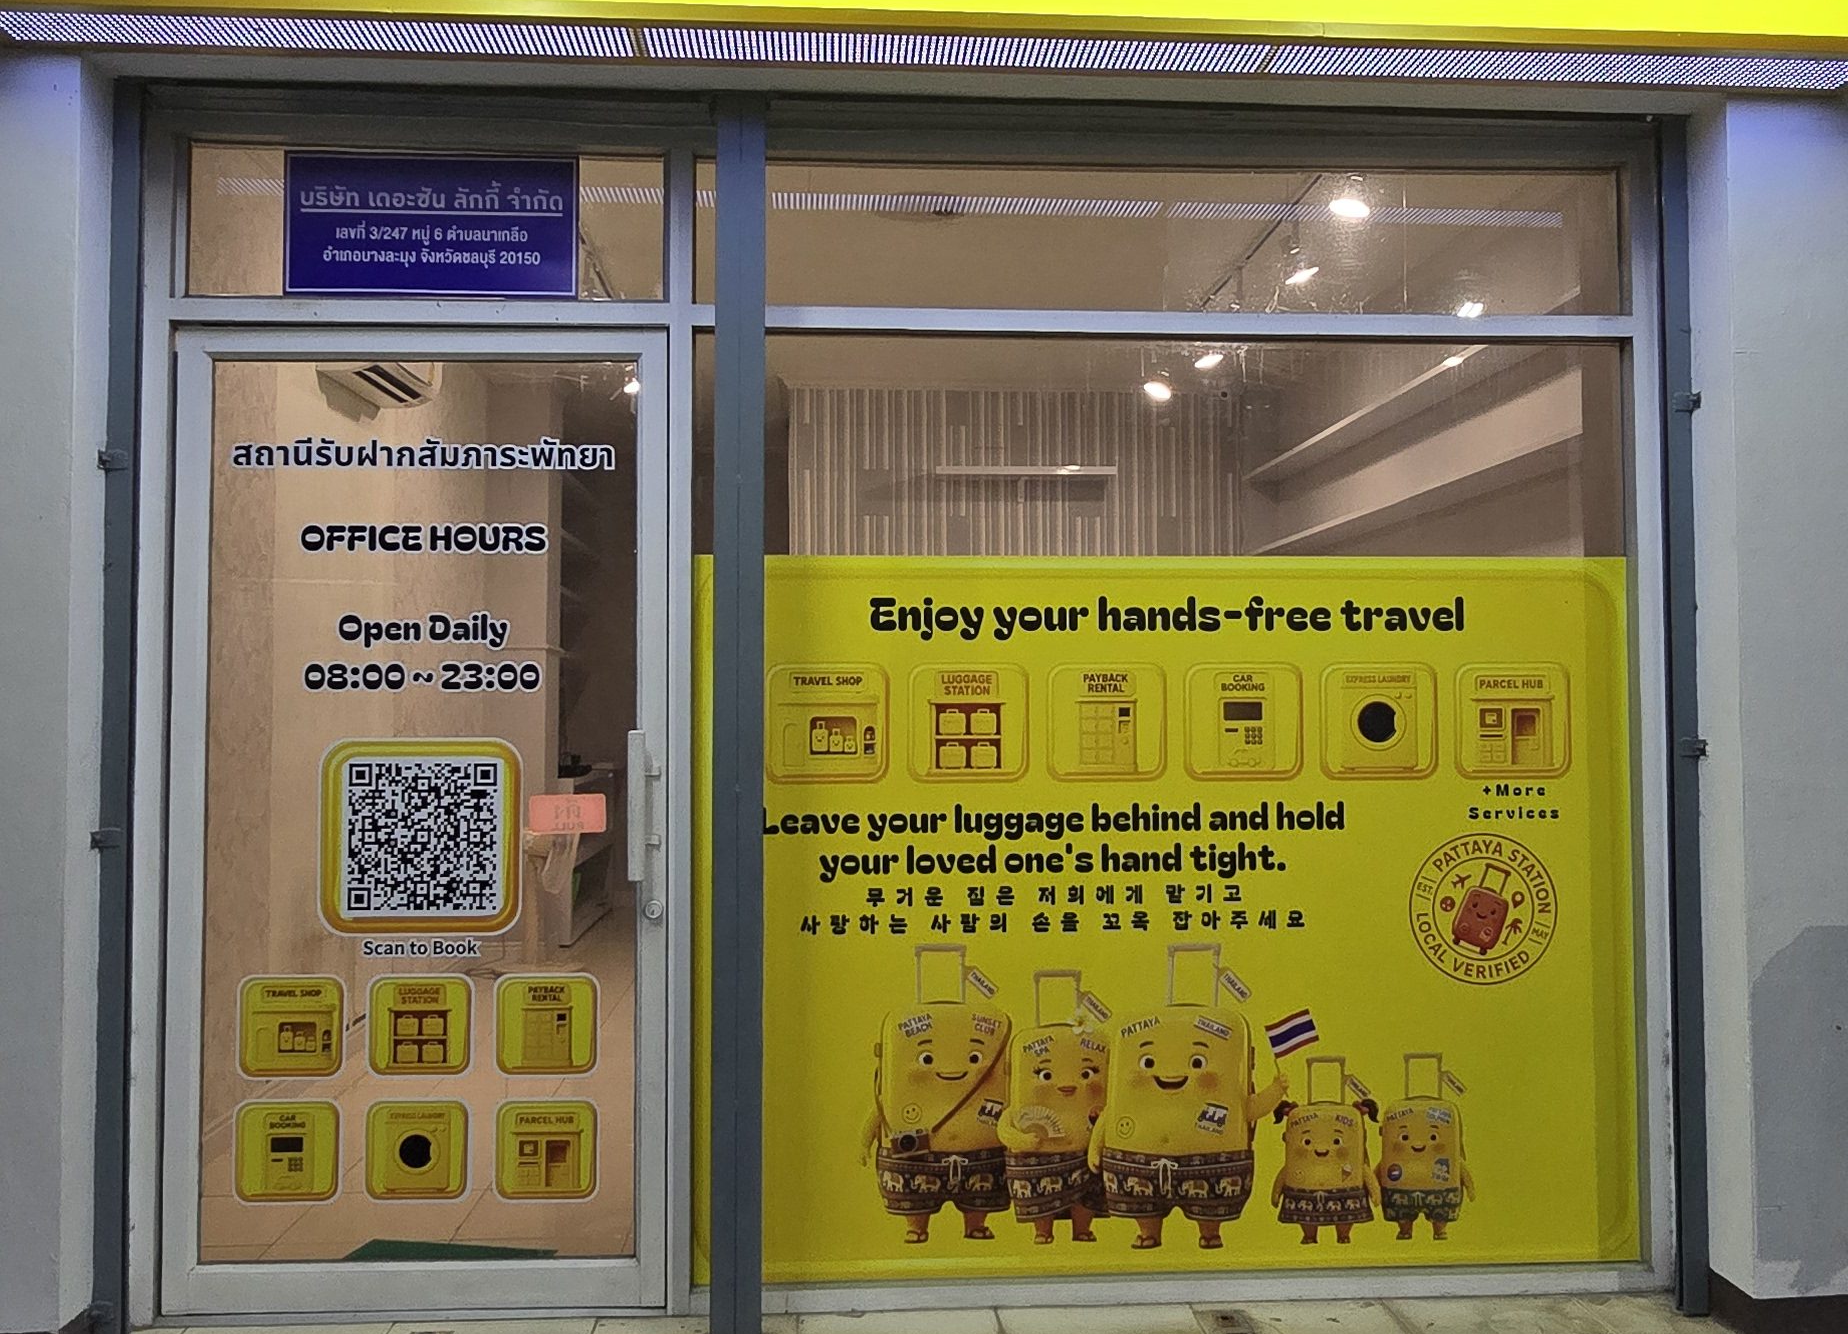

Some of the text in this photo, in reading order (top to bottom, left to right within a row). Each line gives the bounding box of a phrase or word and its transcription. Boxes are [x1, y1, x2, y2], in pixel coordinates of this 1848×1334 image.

[300, 180, 563, 211] บริษัท เดอะซัน ลักกี้ จำกัด
[335, 221, 529, 245] เลขที่ 3/247 หมู่ 6 ตำบลนาเกลือ
[323, 245, 541, 269] อำเภอบางละมุง จังหวัดชลบุรี 20150
[232, 437, 614, 468] สถานีรับฝากสัมภาระพัทยา
[301, 524, 547, 552] OFFICE HOURS
[869, 596, 1465, 641] Enjoy your hands-free travel
[338, 613, 509, 647] Open Daily
[304, 663, 405, 690] 08:00
[441, 663, 540, 690] 23:00
[793, 676, 863, 687] TRAVEL SHOP
[941, 674, 993, 685] LUGGAGE
[1083, 673, 1128, 684] PAYBACK
[1232, 674, 1253, 683] CAR
[1479, 679, 1544, 689] PARCEL HUB
[943, 685, 991, 696] STATION
[1087, 683, 1125, 693] RENTAL
[1221, 682, 1265, 692] BOOKING
[1468, 806, 1560, 819] Services
[763, 801, 1345, 841] Leave your luggage behind and hold
[819, 842, 1286, 882] your loved one's hand tight.
[1432, 839, 1552, 914] PATTAYA STATION
[866, 886, 943, 907] 무거운
[1038, 884, 1143, 905] 저희에게
[1166, 884, 1242, 904] 맡기고
[800, 913, 908, 935] 사랑하는
[931, 912, 1007, 934] 사람의
[1032, 912, 1079, 932] 손을
[1173, 910, 1305, 931] 잡아주세요
[363, 939, 477, 956] Scan to Book
[1416, 912, 1530, 979] LOCAL VERIFIED
[265, 989, 322, 999] TRAVEL SHOP
[399, 986, 441, 996] LUGGAGE
[528, 985, 565, 995] PAYBACK
[401, 995, 439, 1005] STATION
[532, 994, 562, 1003] RENTAL
[898, 1013, 933, 1031] PATTAYA
[971, 1013, 1002, 1029] SUNSET
[1121, 1016, 1161, 1038] PATTAYA
[904, 1022, 933, 1038] BEACH
[974, 1023, 995, 1036] CLUB
[1023, 1035, 1055, 1054] PATTAYA
[1035, 1046, 1050, 1057] SPA
[1080, 1038, 1106, 1054] RELAX
[279, 1114, 296, 1122] CAR
[519, 1115, 574, 1125] PARCEL HUB
[1335, 1114, 1354, 1127] KIDS
